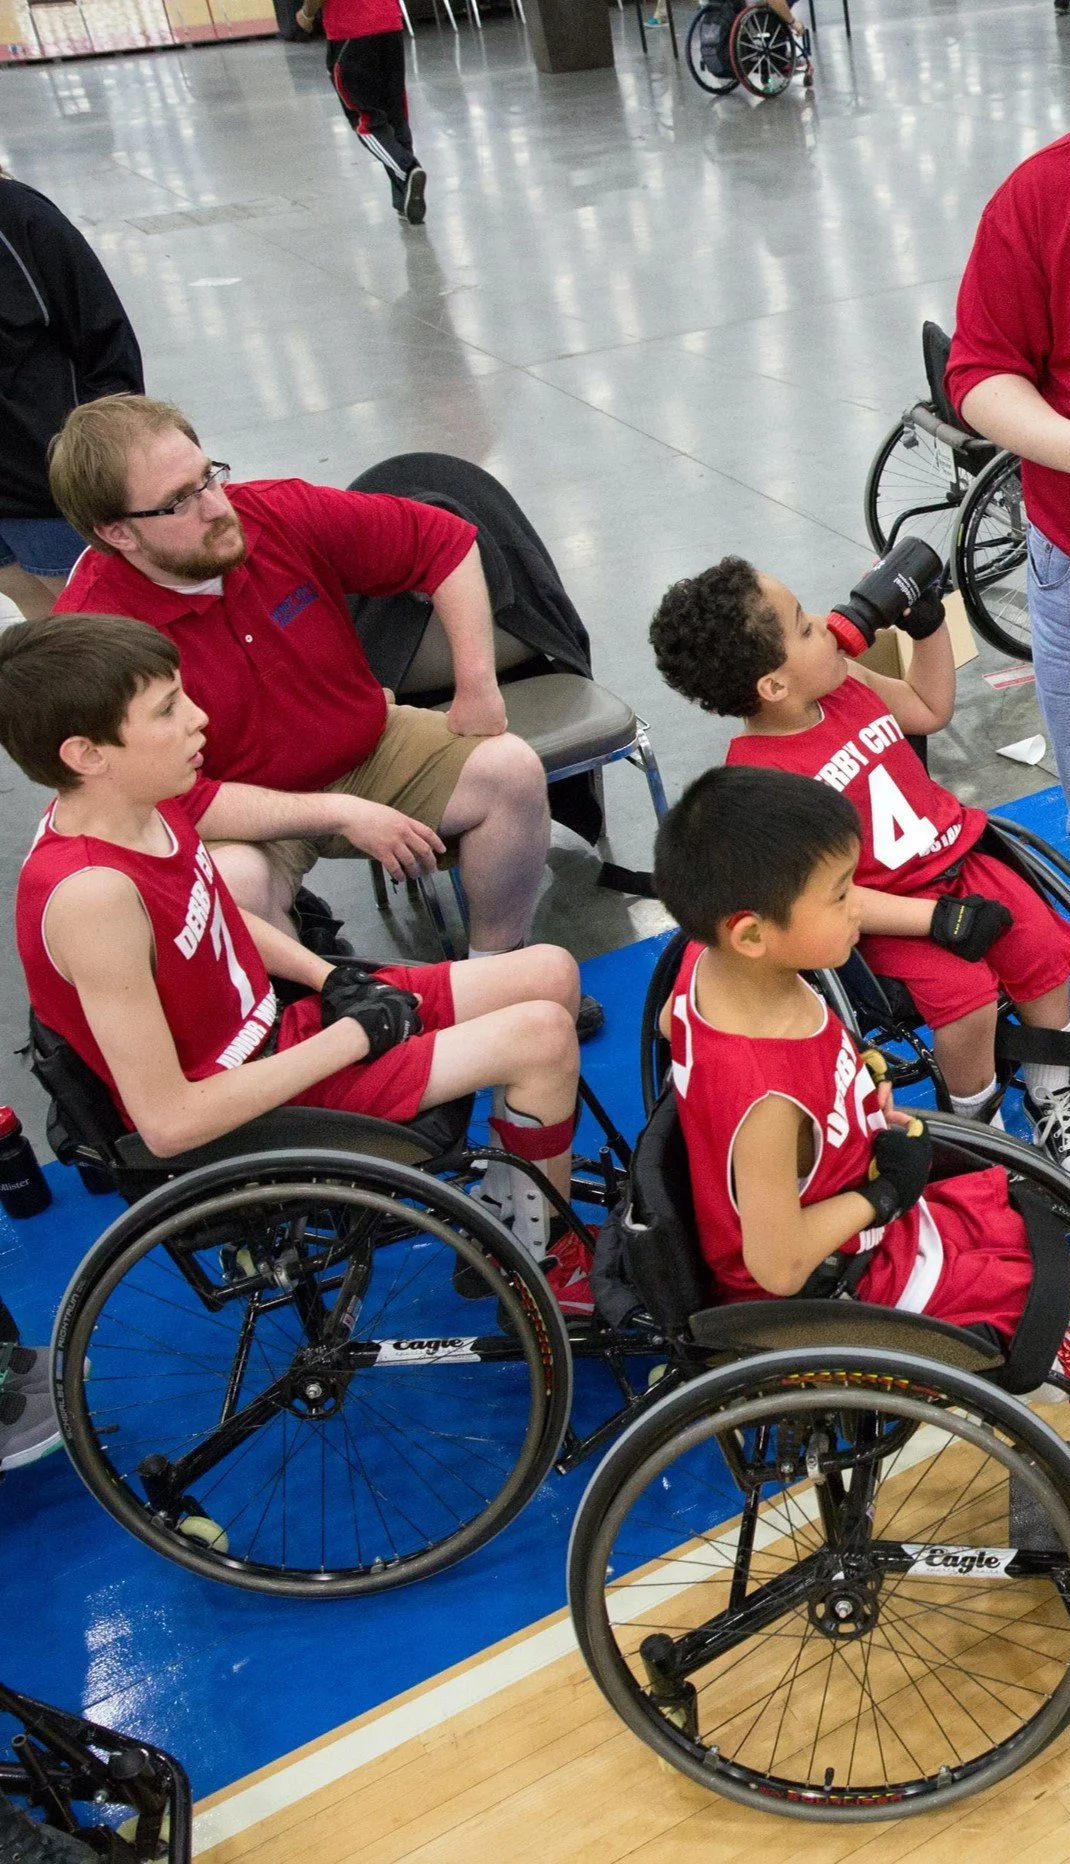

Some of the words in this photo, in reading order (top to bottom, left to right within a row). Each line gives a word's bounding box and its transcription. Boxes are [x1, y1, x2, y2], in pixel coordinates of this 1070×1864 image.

[867, 763, 939, 871] 4
[210, 888, 256, 1020] 7
[0, 1178, 30, 1192] llister
[924, 1548, 1001, 1574] Eagle
